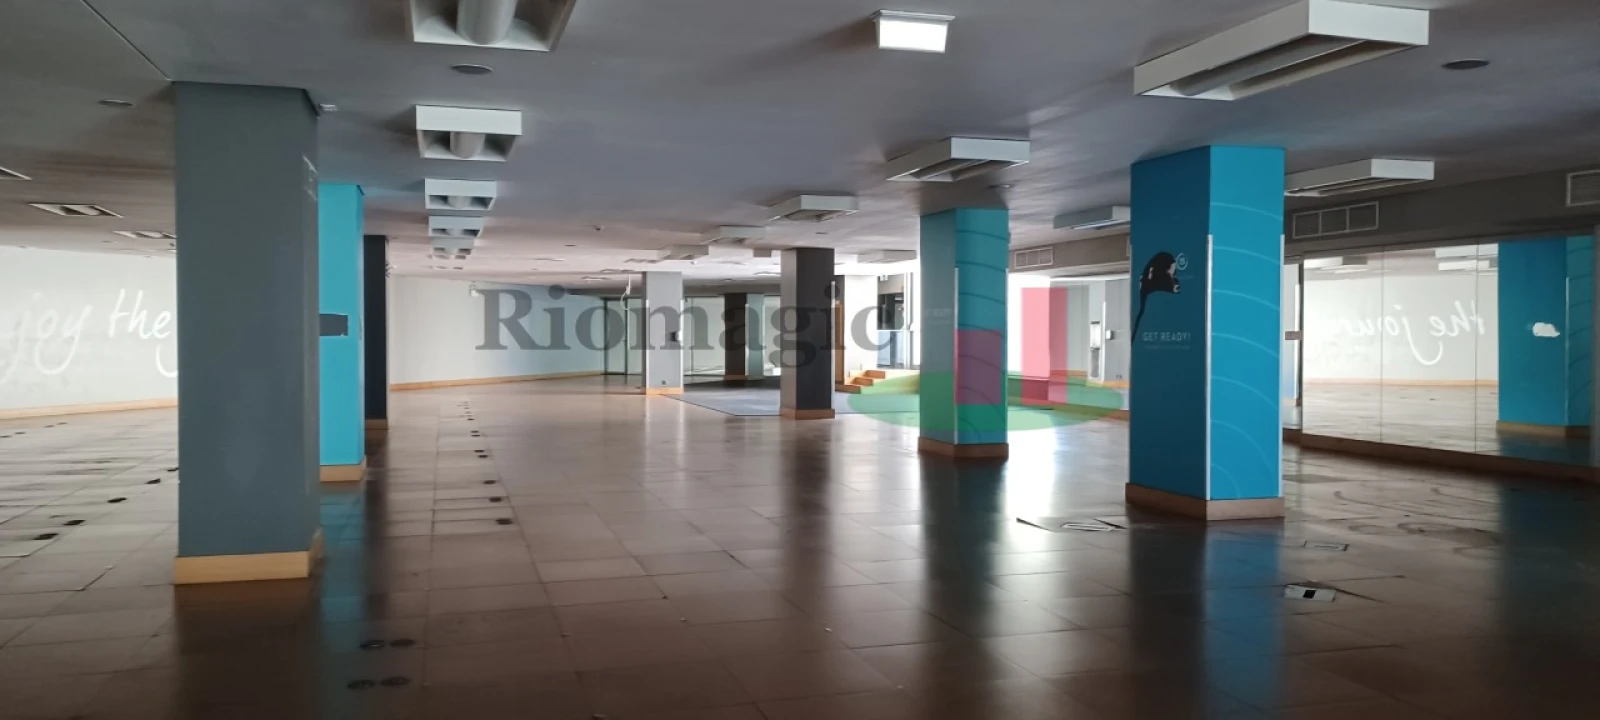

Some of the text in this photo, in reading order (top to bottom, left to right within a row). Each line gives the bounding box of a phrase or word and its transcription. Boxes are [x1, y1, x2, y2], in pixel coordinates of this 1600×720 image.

[0, 291, 94, 384] joy
[109, 287, 172, 340] the
[1142, 331, 1191, 342] GET READY!
